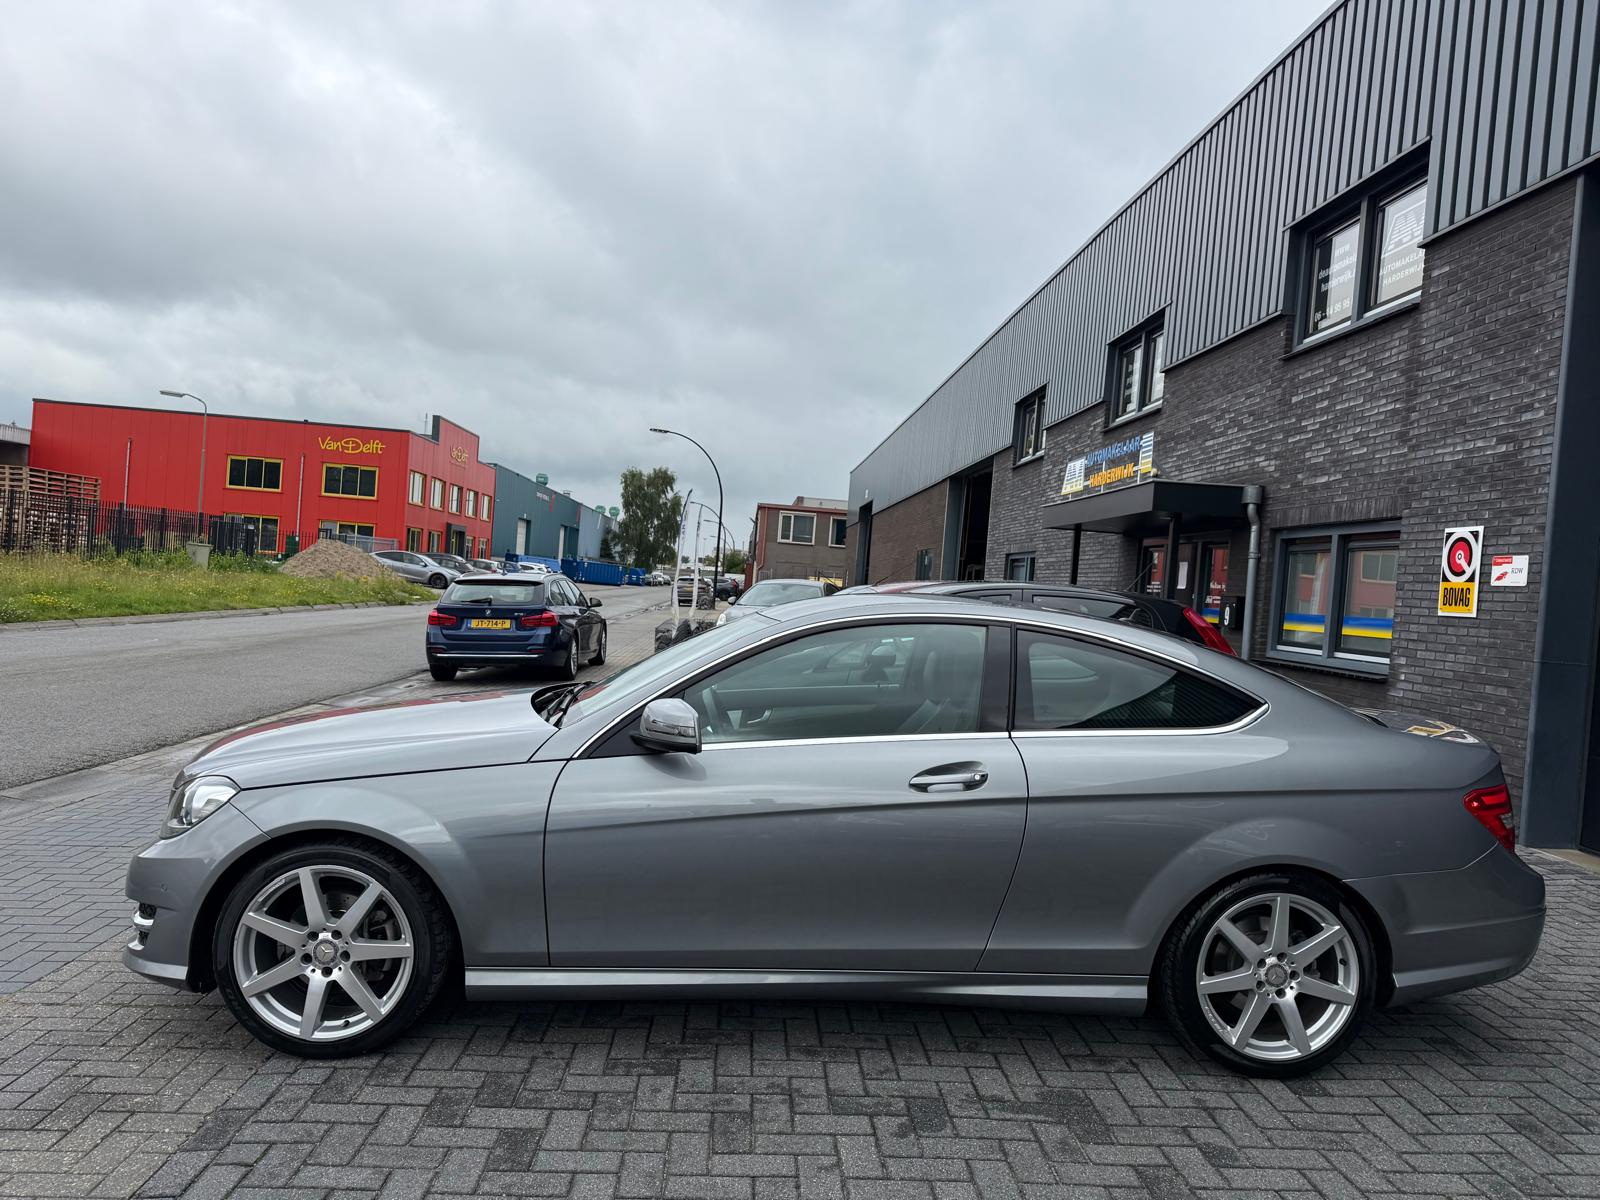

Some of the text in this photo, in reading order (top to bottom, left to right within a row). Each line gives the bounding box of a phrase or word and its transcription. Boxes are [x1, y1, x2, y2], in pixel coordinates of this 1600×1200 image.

[1382, 262, 1424, 286] HARDERWIJ
[1086, 435, 1140, 467] AUTOMAKELAAR
[1089, 462, 1134, 488] HARDERWIJK
[1443, 587, 1471, 607] BOVAG
[475, 619, 506, 628] JT-714-P
